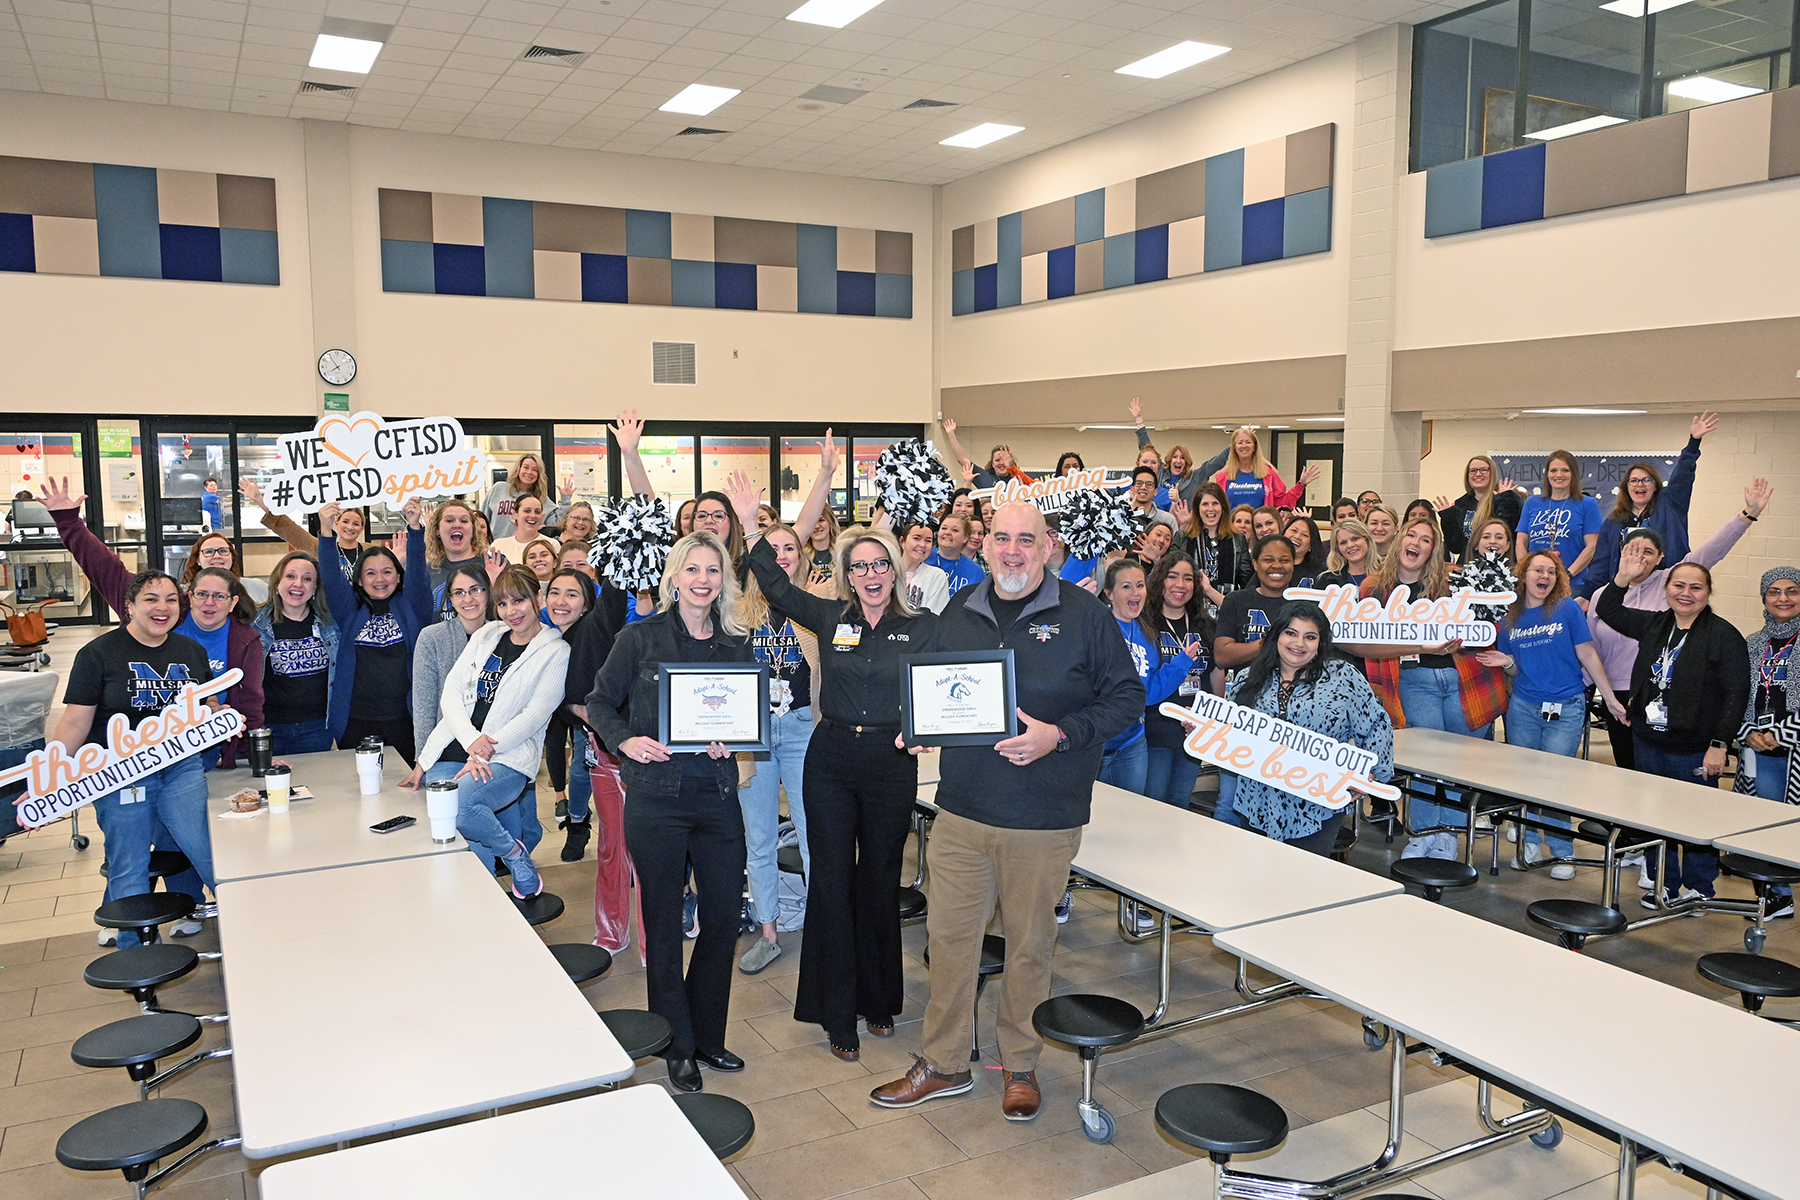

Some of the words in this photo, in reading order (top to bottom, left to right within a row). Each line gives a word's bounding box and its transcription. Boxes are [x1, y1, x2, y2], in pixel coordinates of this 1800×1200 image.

[286, 437, 329, 471] WE
[374, 423, 457, 460] CFISD
[1498, 463, 1542, 482] WHEN
[1598, 463, 1629, 483] DRE
[984, 468, 1118, 507] blooming
[1530, 508, 1571, 527] LEAD
[1308, 588, 1382, 623] the
[1388, 588, 1490, 624] best
[1332, 621, 1418, 641] ORTUNITIES
[1422, 622, 1439, 641] IN
[1444, 623, 1492, 642] CFISD
[1509, 622, 1564, 641] Mustangs
[273, 658, 330, 672] COUNSELO
[280, 648, 327, 661] SCHOOL
[1161, 647, 1204, 656] MILP
[5, 745, 108, 797] the
[113, 679, 222, 753] best
[1194, 695, 1268, 736] MILLSAP
[1268, 722, 1333, 762] BRINGS
[1335, 745, 1373, 776] OUT
[23, 747, 162, 823] OPPORTUNITIES
[163, 736, 186, 759] IN
[185, 712, 239, 748] CFISD
[1176, 714, 1254, 769] the
[1260, 744, 1374, 804] best
